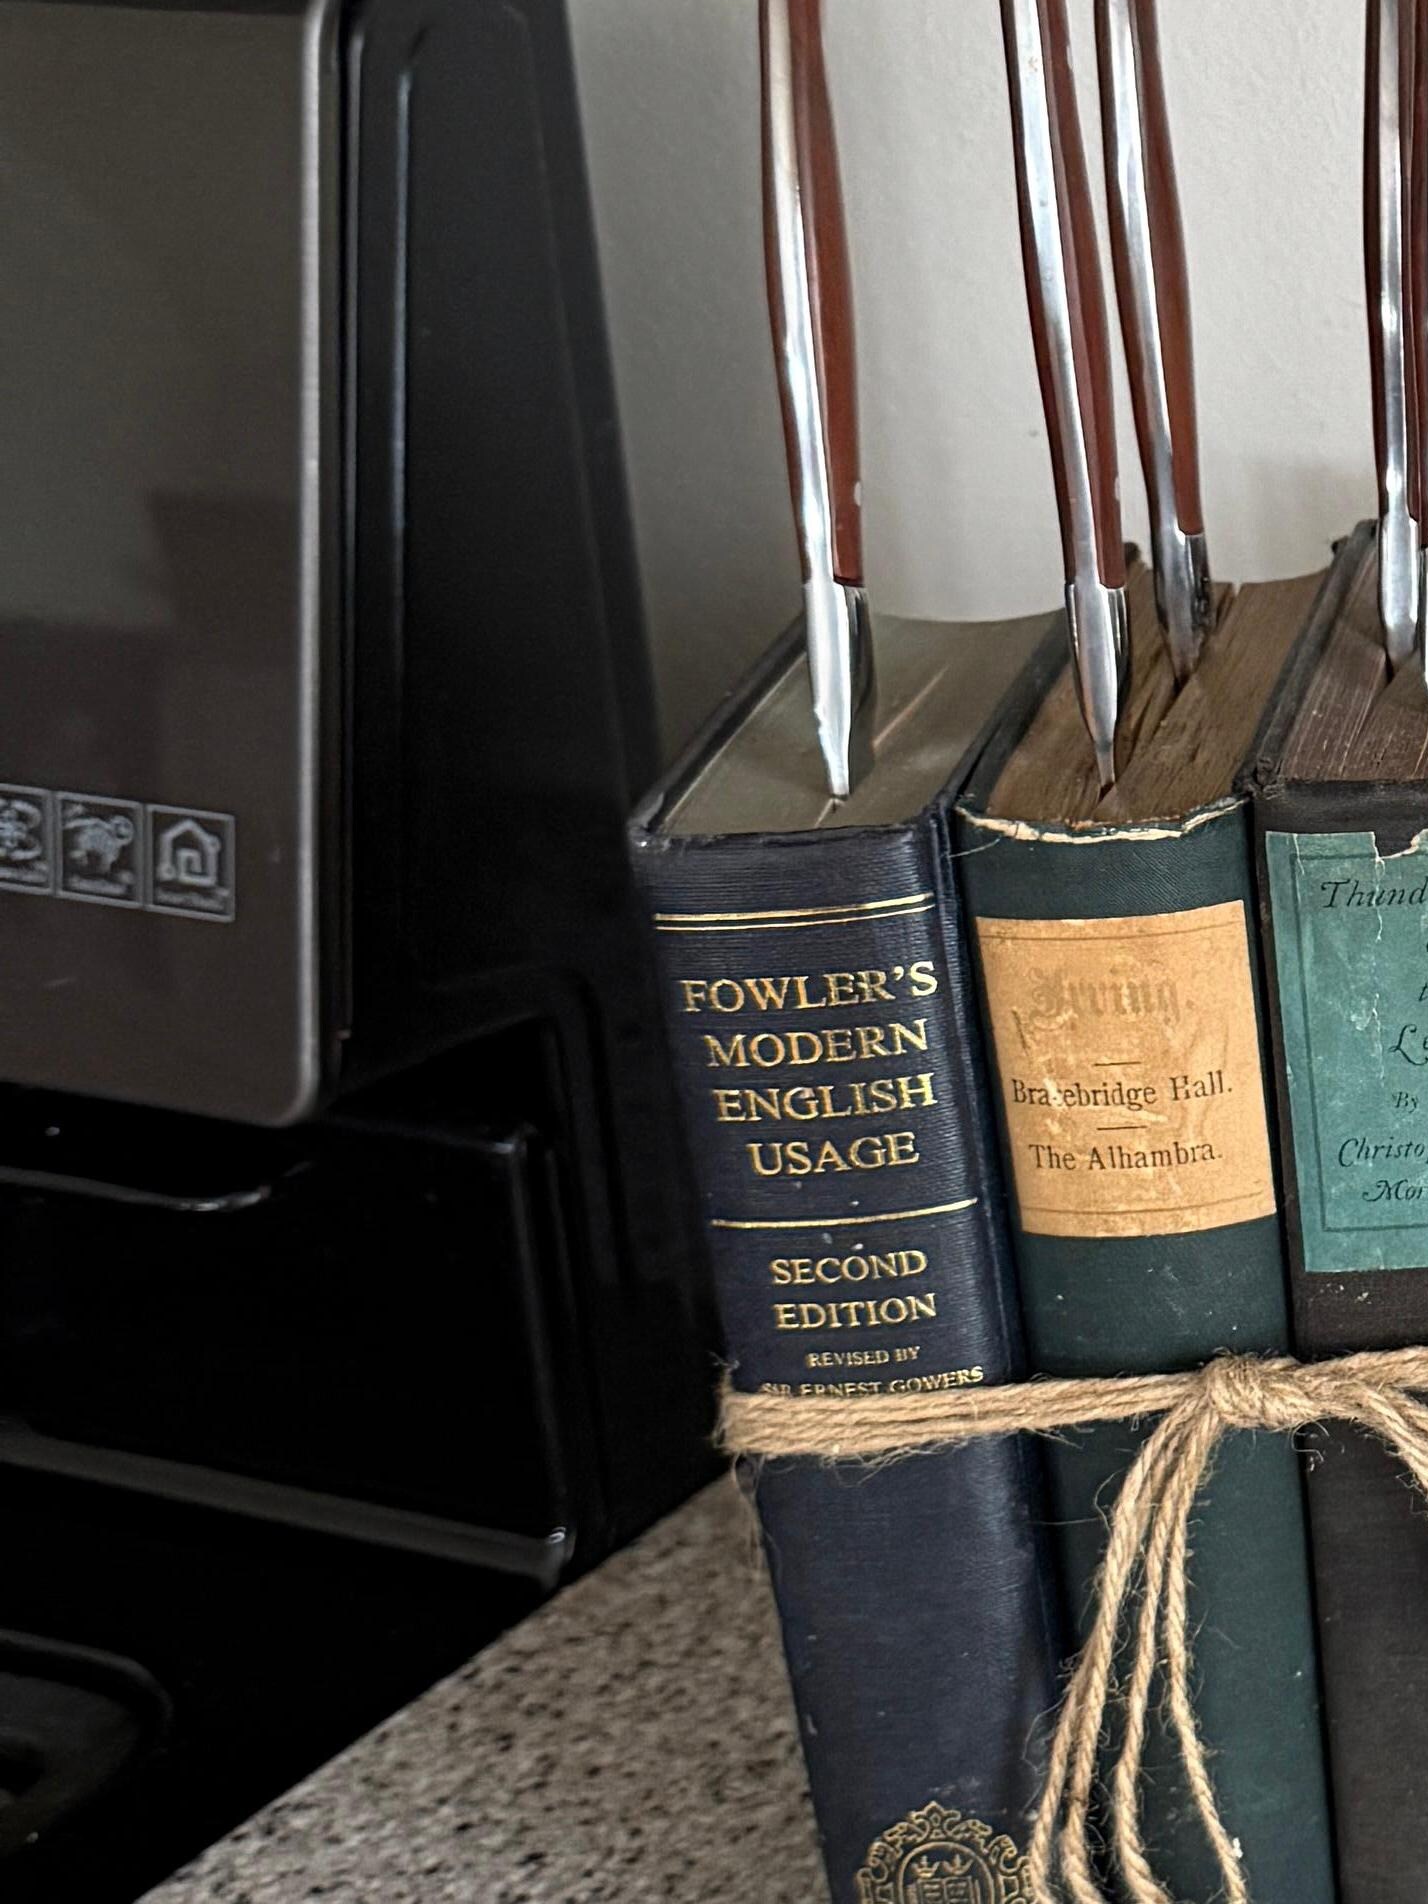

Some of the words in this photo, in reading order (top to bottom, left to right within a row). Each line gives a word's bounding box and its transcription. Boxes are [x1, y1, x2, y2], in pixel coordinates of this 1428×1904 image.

[676, 960, 938, 1012] FOWLER'S
[703, 1019, 930, 1069] MODERN
[713, 1072, 937, 1123] ENGLISH
[1169, 1069, 1233, 1101] Hall.
[1391, 1091, 1420, 1114] By
[746, 1131, 920, 1176] USAGE
[1029, 1144, 1076, 1170] The
[1088, 1141, 1223, 1170] Alhambra.
[770, 1249, 927, 1283] SECOND
[773, 1293, 936, 1329] EDITION
[806, 1349, 889, 1368] REVISED
[895, 1345, 920, 1362] BY
[800, 1381, 883, 1395] ERNEST
[889, 1365, 984, 1393] GOWERS
